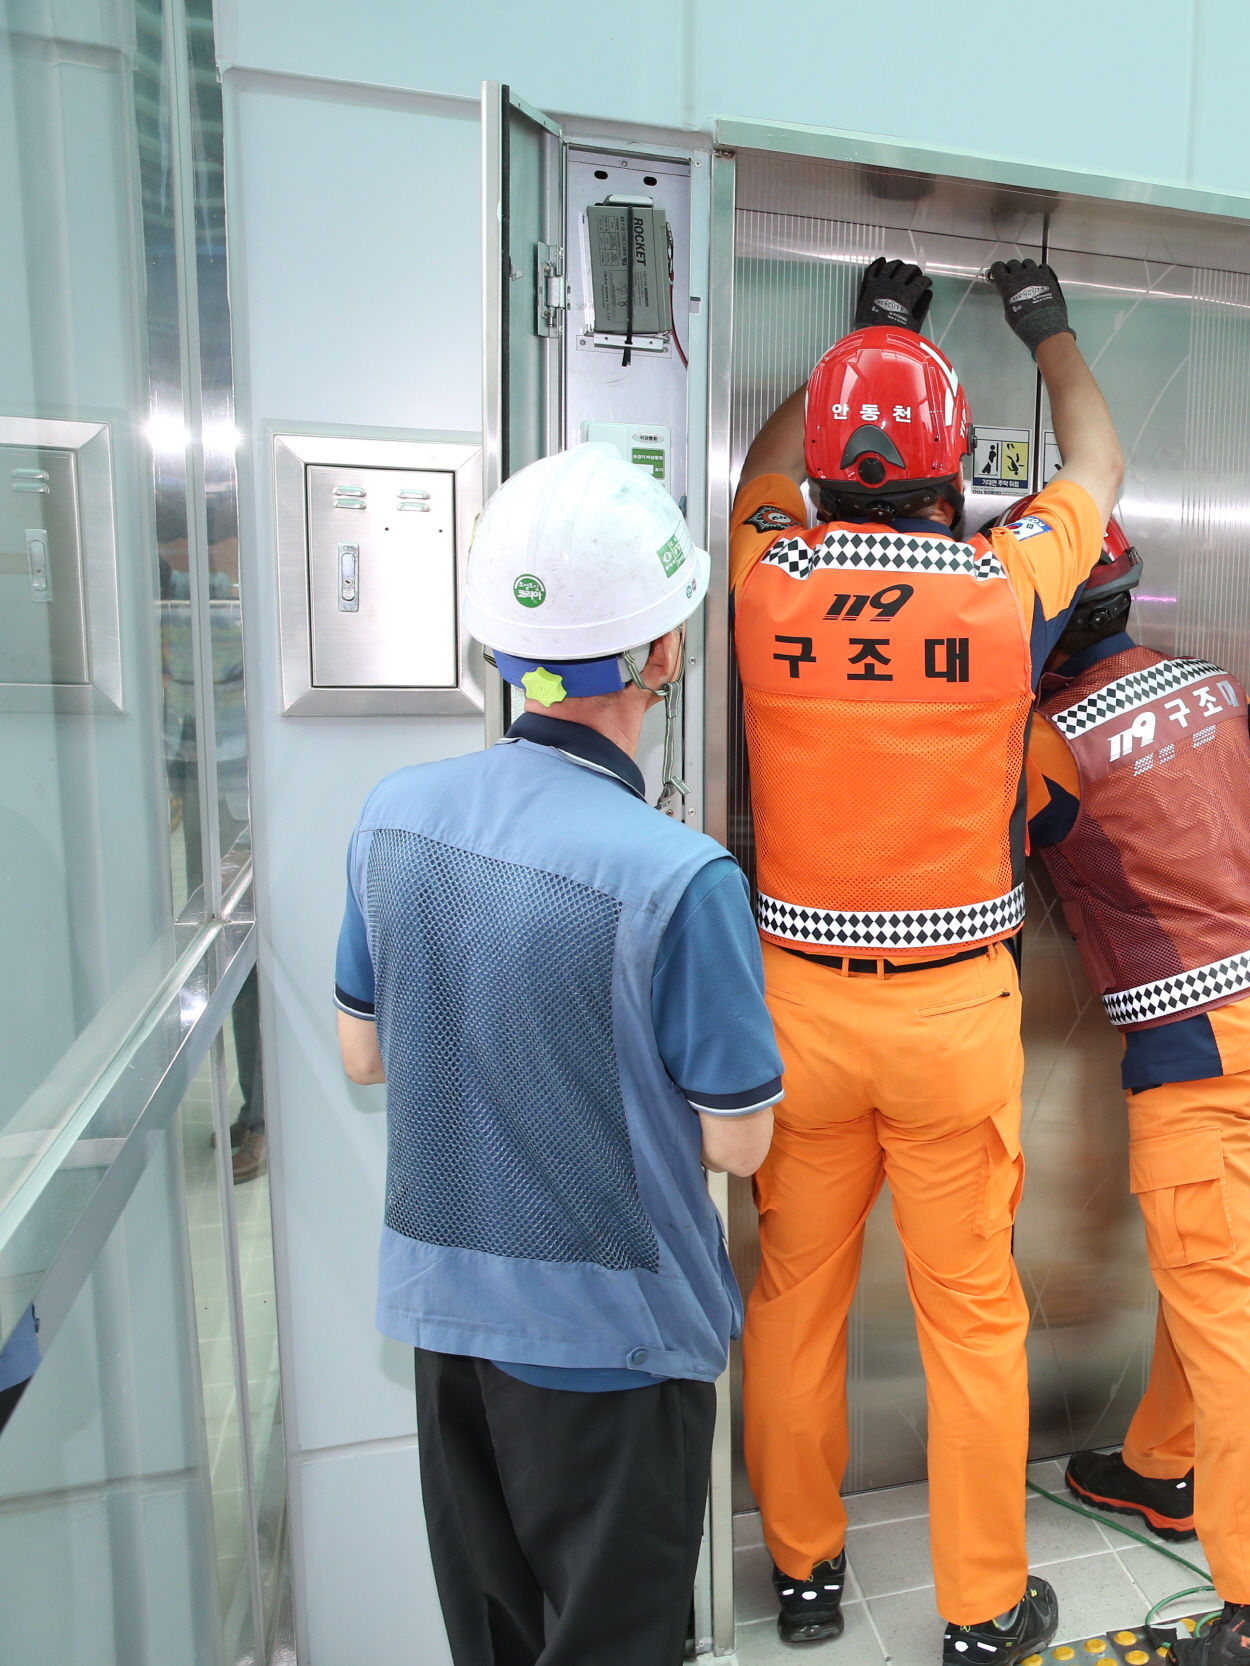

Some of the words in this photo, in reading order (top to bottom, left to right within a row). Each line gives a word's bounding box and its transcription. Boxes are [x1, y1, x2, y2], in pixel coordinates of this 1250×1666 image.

[633, 216, 647, 267] ROCKET
[831, 403, 912, 423] 안동천
[517, 589, 543, 603] 코리아
[822, 583, 915, 622] 119
[773, 634, 970, 683] 구조대
[1107, 711, 1157, 763] 119
